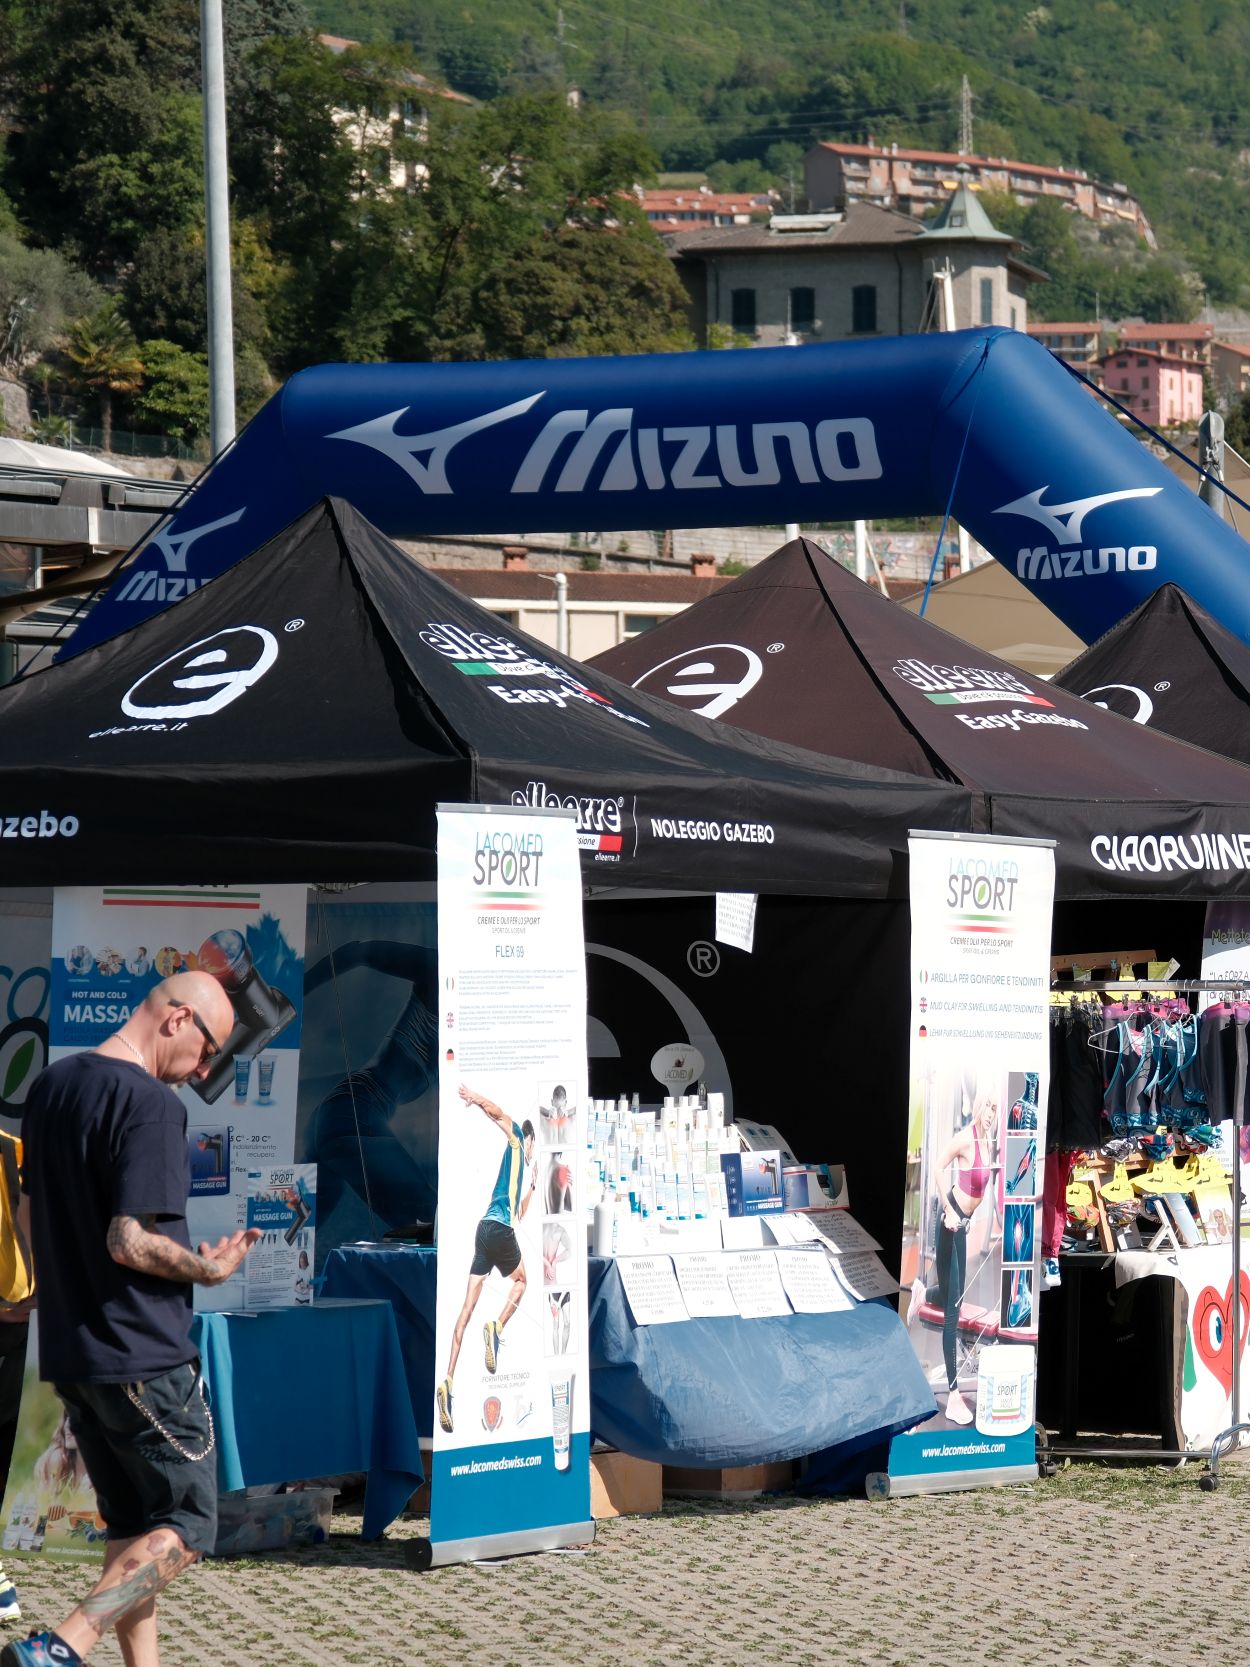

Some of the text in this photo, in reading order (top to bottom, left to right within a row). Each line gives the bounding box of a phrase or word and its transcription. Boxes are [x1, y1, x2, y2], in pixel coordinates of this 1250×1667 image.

[510, 407, 883, 493] MIZUNO
[1017, 546, 1157, 580] MIZUNO
[0, 810, 79, 838] zebo
[651, 818, 775, 844] NOLEGGIO GAZEBO
[577, 837, 596, 846] sione
[473, 849, 543, 887] SPORT
[947, 874, 1018, 911] SPORT
[495, 945, 514, 958] FLEX
[931, 973, 957, 983] ARGILLA
[970, 974, 1005, 985] GONFIORE
[64, 1004, 138, 1024] MASSA
[253, 1212, 293, 1222] MASSAGE GUN
[922, 1442, 1006, 1458] www.lacomedswiss.com
[451, 1455, 542, 1476] www.lacomedswiss.com
